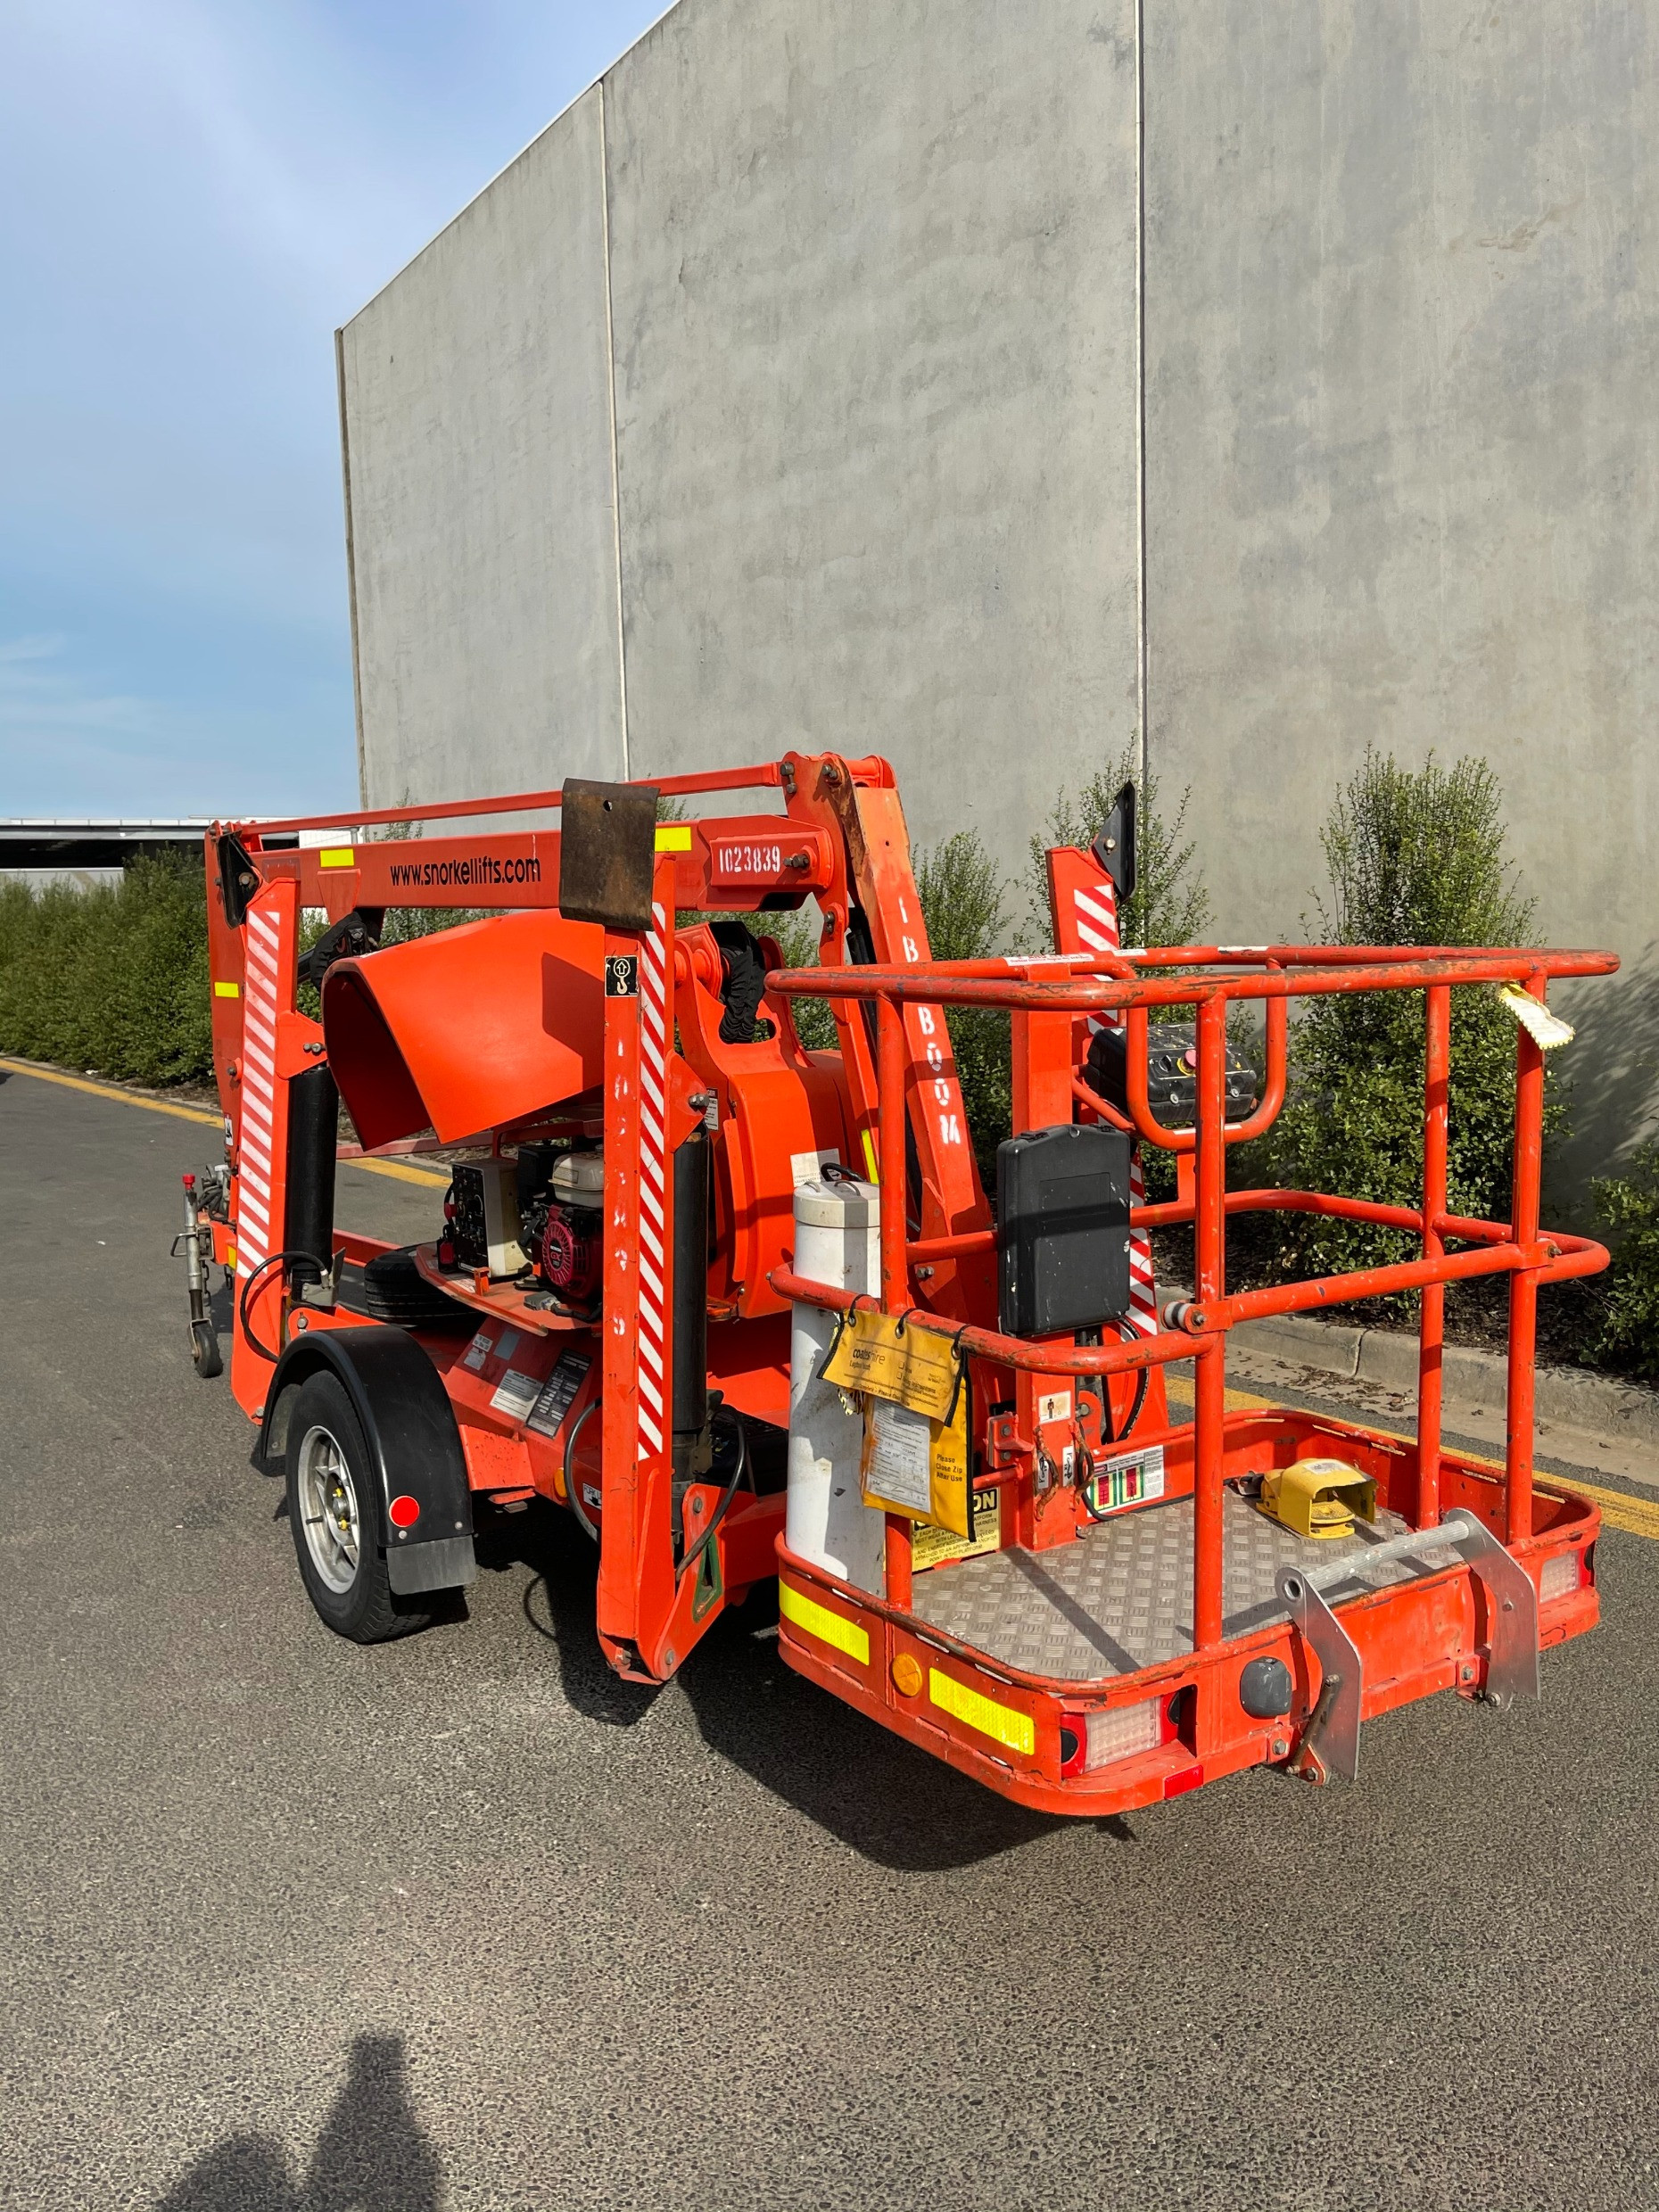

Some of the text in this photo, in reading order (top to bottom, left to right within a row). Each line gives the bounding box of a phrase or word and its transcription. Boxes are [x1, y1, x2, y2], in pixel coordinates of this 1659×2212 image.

[719, 846, 780, 873] 1023839
[390, 855, 541, 887] www.snorkellifts.com
[937, 1453, 956, 1464] Please
[936, 1463, 963, 1474] Close Zip
[937, 1472, 950, 1482] After
